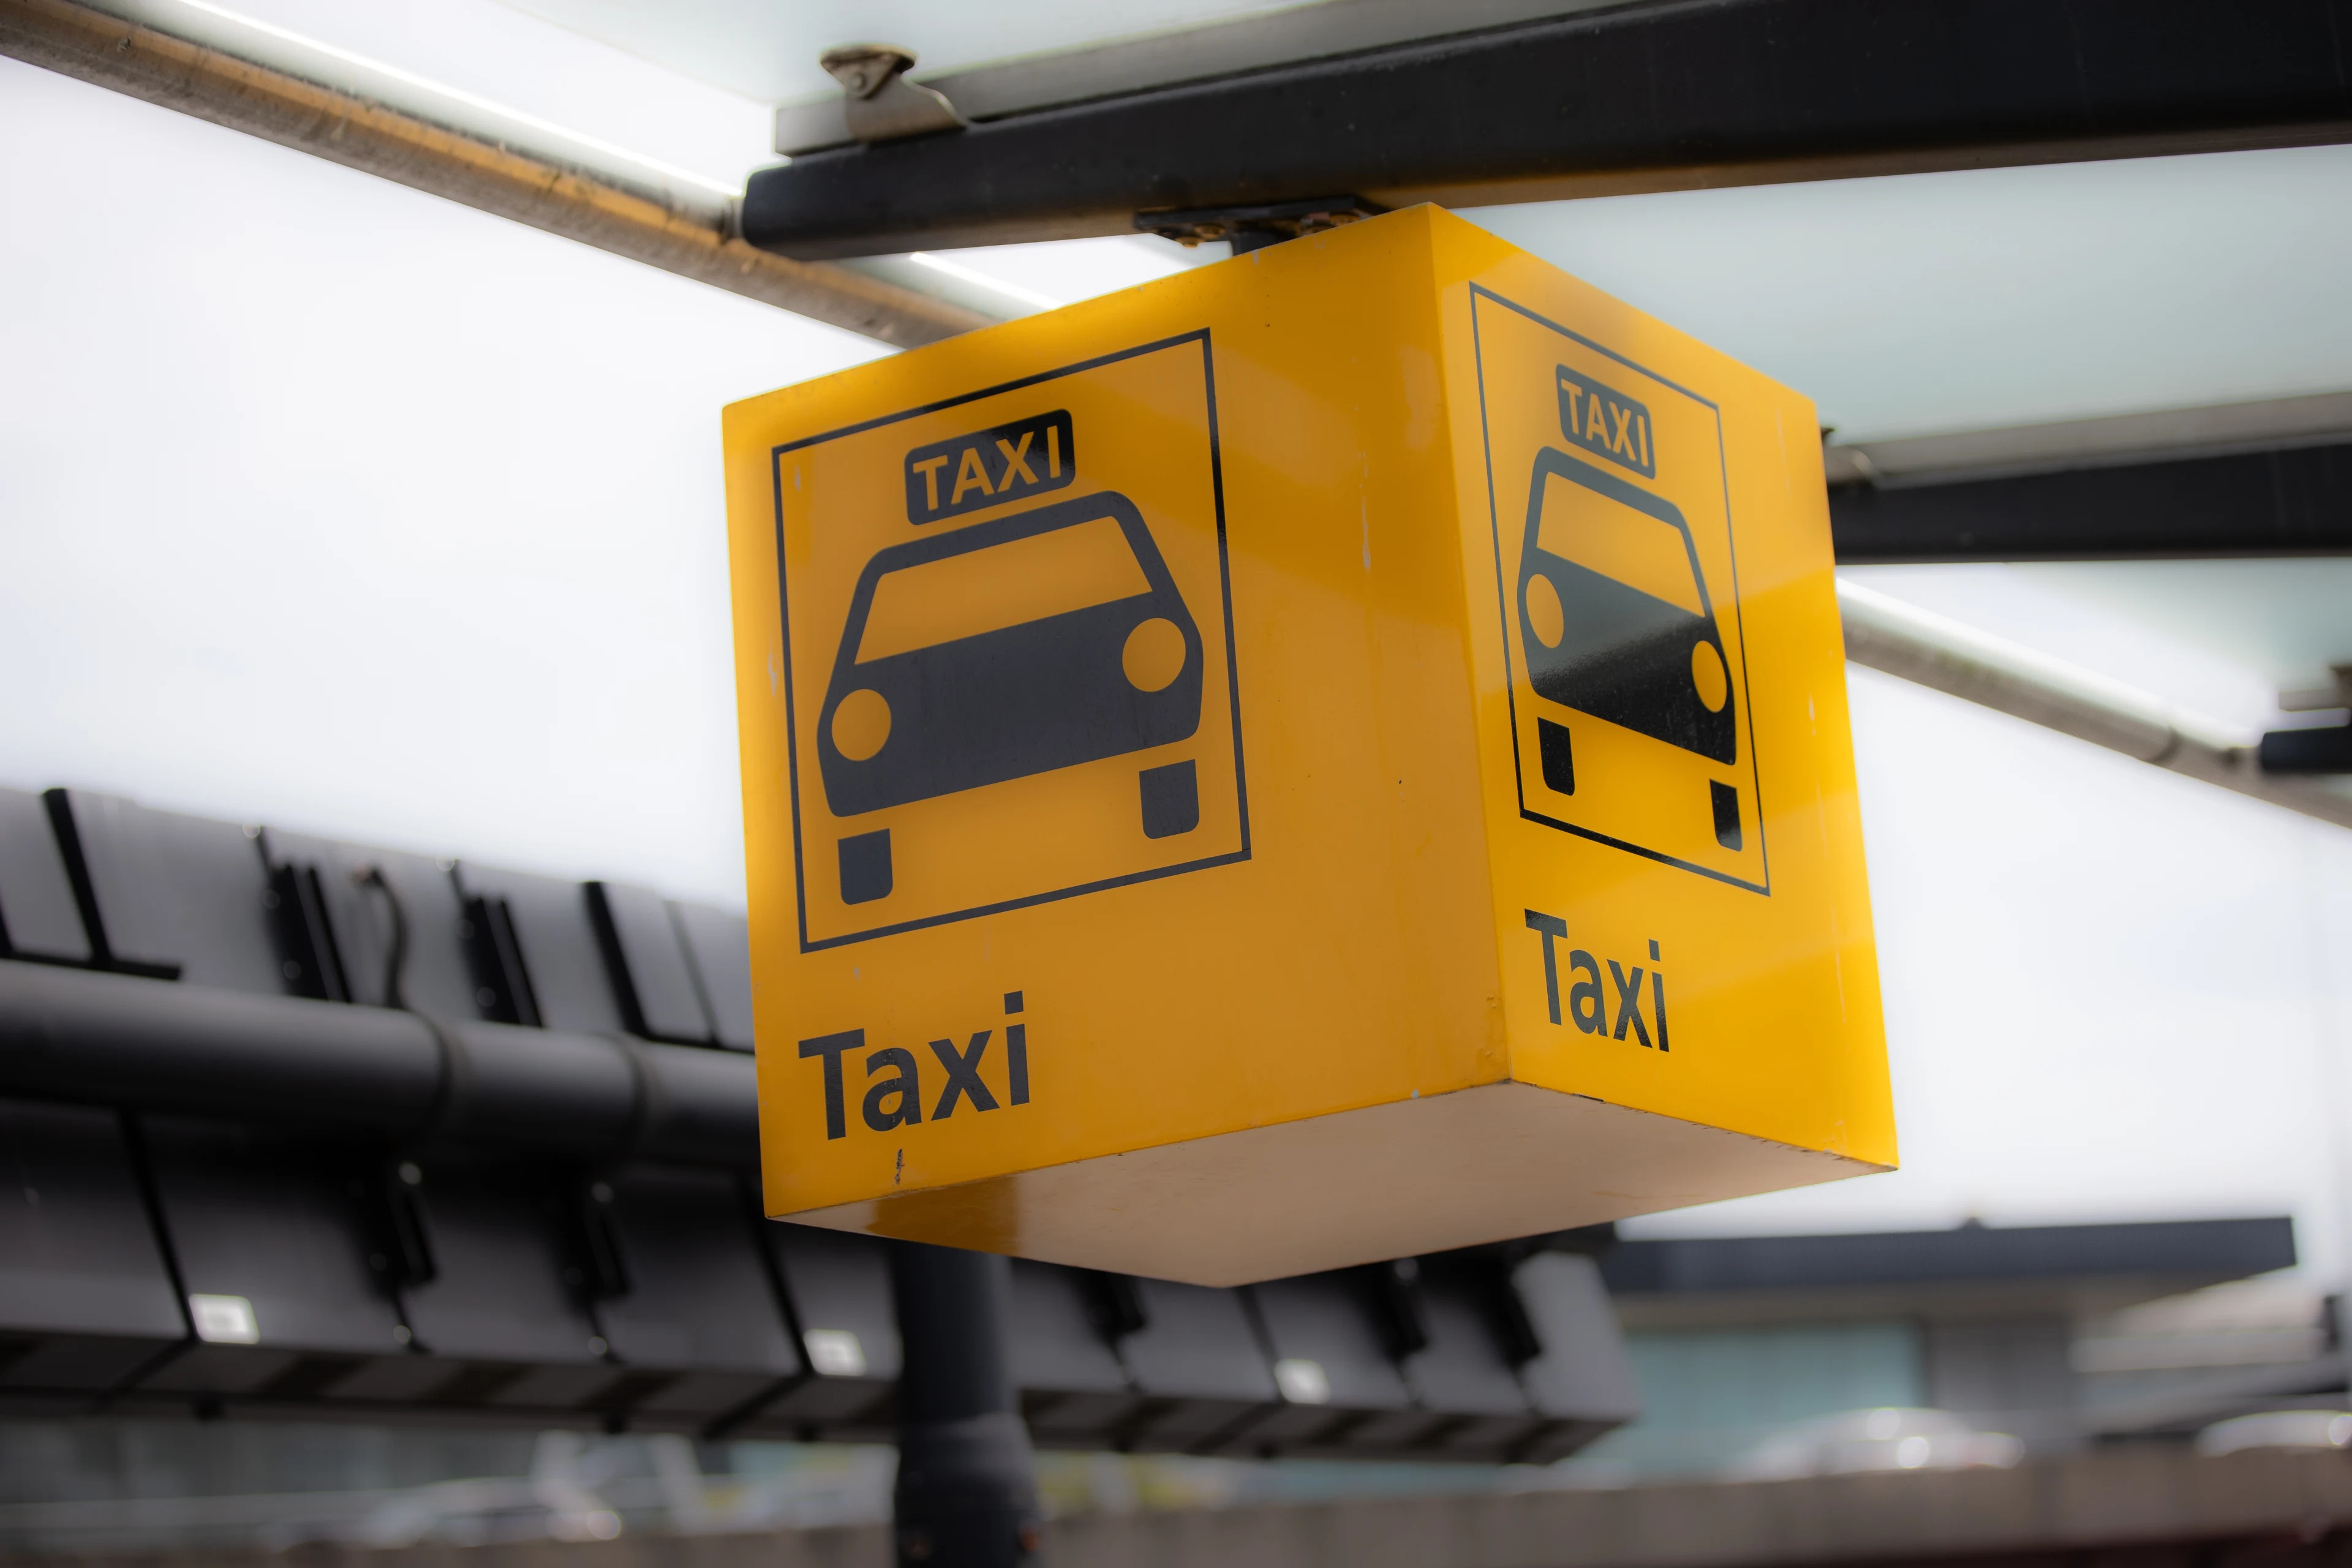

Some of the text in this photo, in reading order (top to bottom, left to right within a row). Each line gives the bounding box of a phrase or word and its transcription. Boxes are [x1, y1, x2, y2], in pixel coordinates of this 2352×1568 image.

[912, 424, 1061, 511] TAXI
[1561, 378, 1649, 468] TAXI
[1524, 908, 1670, 1053] Taxi
[797, 990, 1030, 1140] Taxi
